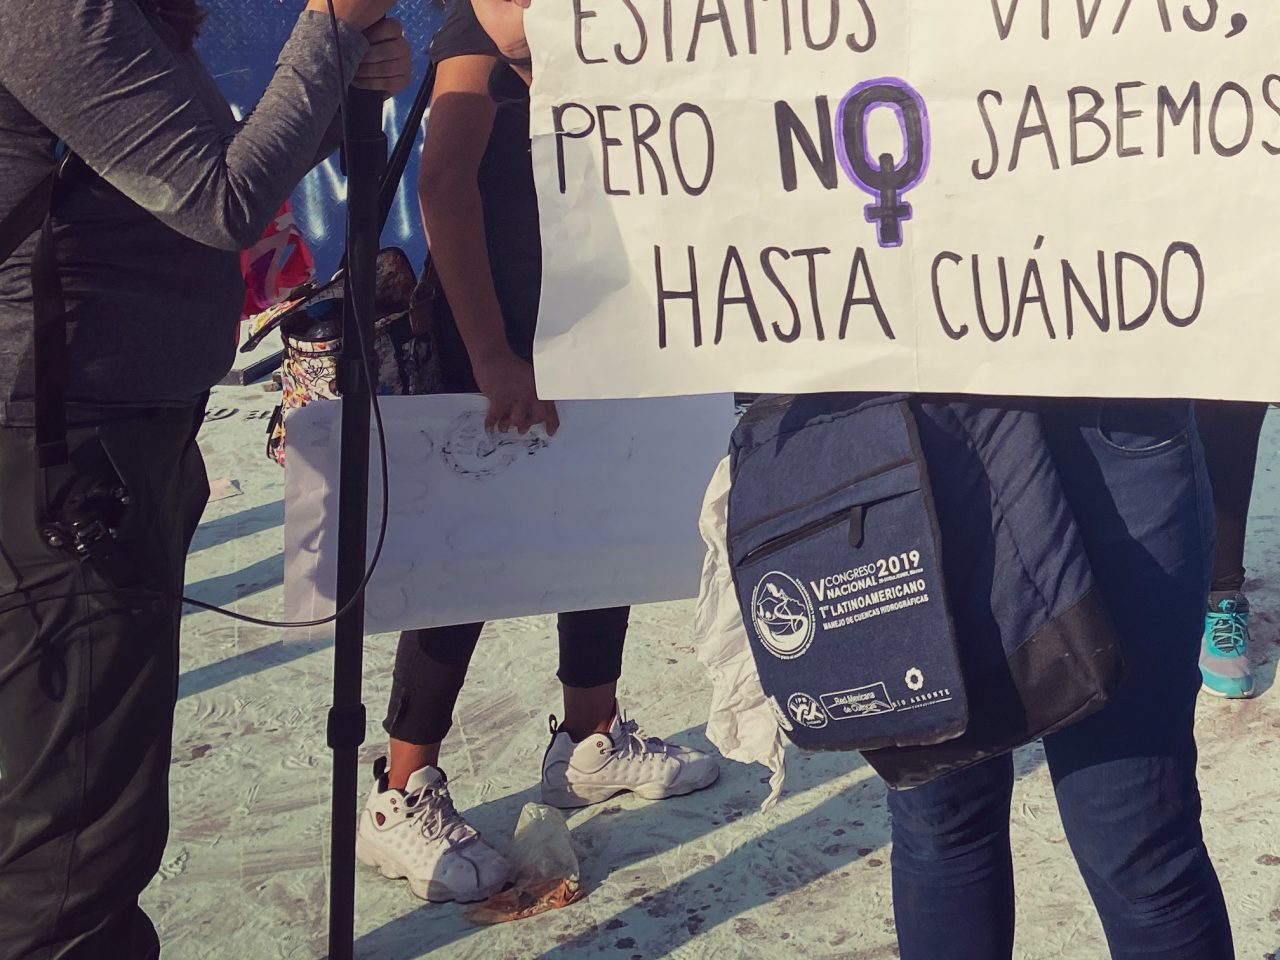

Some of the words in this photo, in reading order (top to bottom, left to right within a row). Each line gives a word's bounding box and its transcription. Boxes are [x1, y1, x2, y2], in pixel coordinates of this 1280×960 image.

[552, 100, 716, 198] PERO
[775, 80, 930, 230] NO
[652, 243, 898, 350] HASTA
[929, 235, 1206, 344] CUÁNDO
[810, 578, 825, 602] V
[825, 563, 876, 587] CONGRESO
[876, 549, 920, 578] 2019
[827, 575, 878, 600] NACIONAL
[830, 578, 926, 617] LATINOAMERICANO
[823, 620, 846, 631] MANEJO
[846, 616, 855, 624] DE
